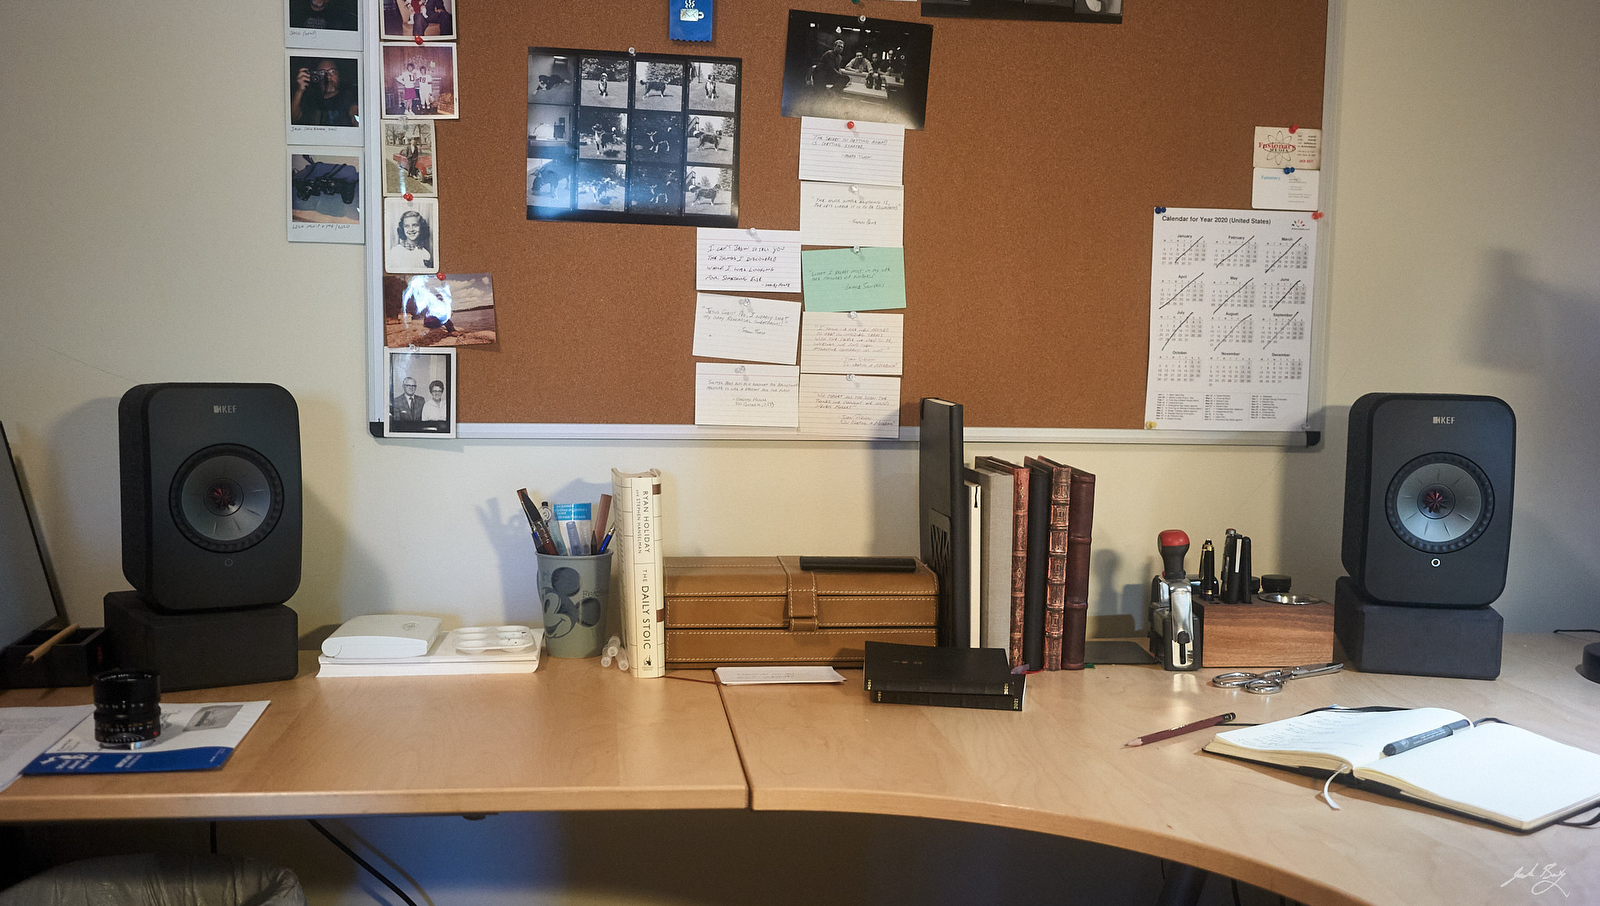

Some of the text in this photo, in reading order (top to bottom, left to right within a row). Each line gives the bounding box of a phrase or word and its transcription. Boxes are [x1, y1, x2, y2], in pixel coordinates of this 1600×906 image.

[1258, 142, 1296, 152] Fusionary
[642, 586, 650, 615] DAILY
[643, 618, 651, 650] STOIC
